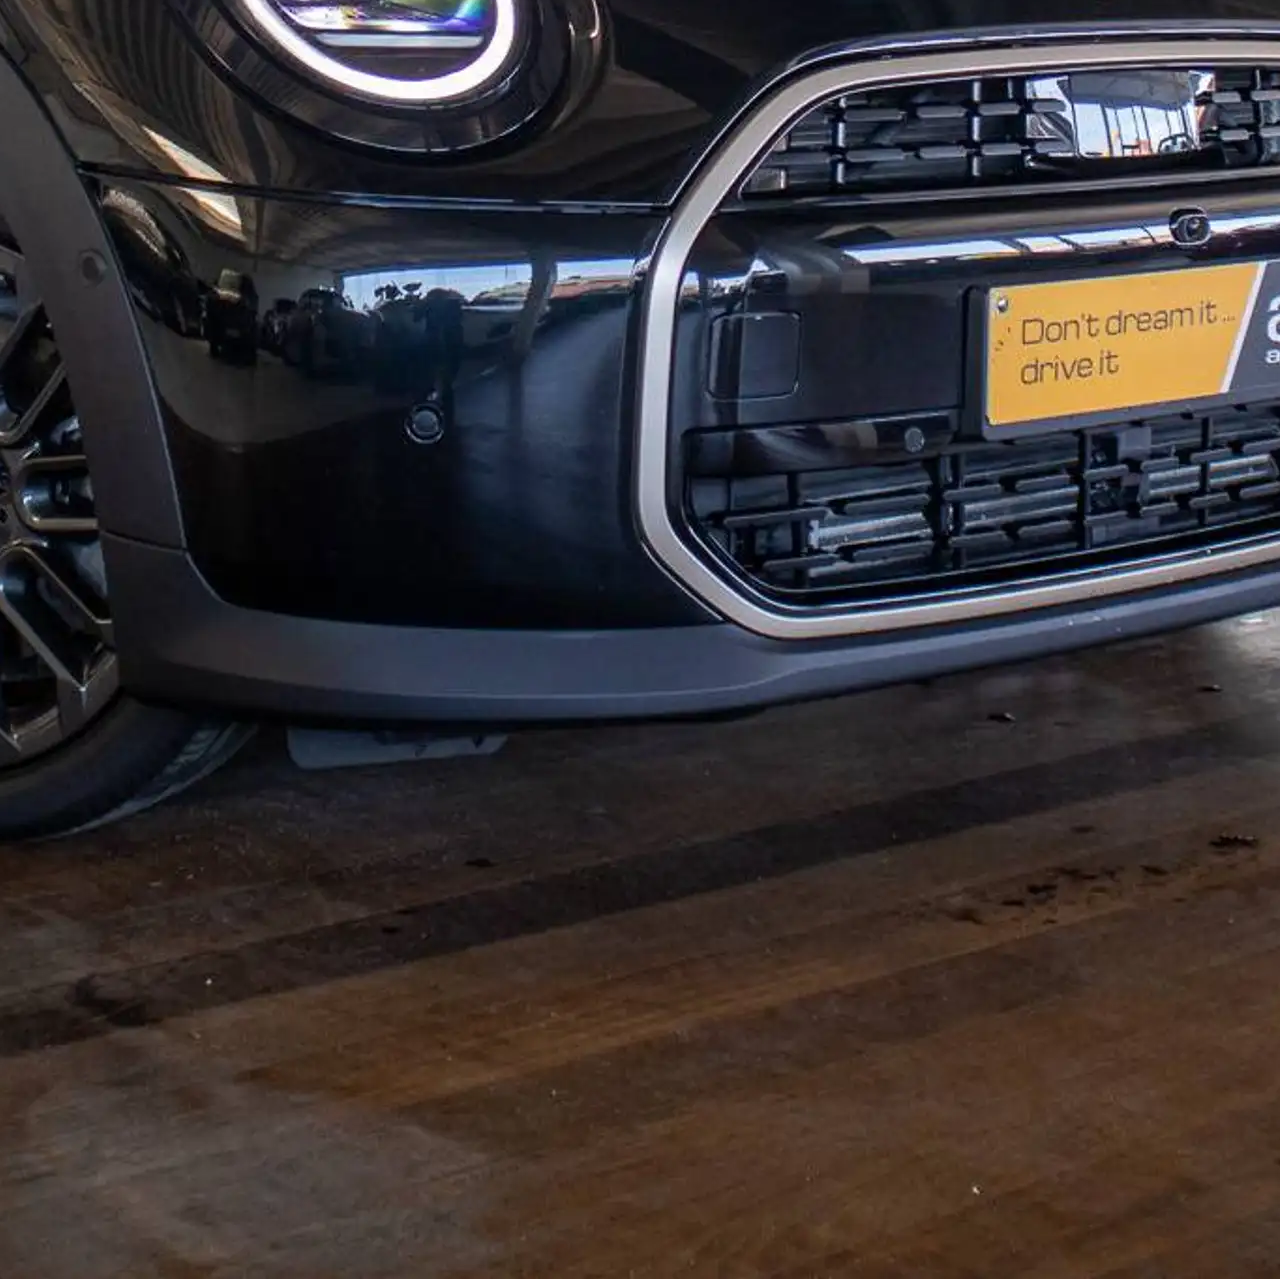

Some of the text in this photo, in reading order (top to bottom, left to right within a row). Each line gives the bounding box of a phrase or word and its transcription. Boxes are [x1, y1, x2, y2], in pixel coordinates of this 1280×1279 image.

[1021, 312, 1100, 345] Don't
[1104, 308, 1195, 337] dream
[1020, 348, 1120, 385] drive it
